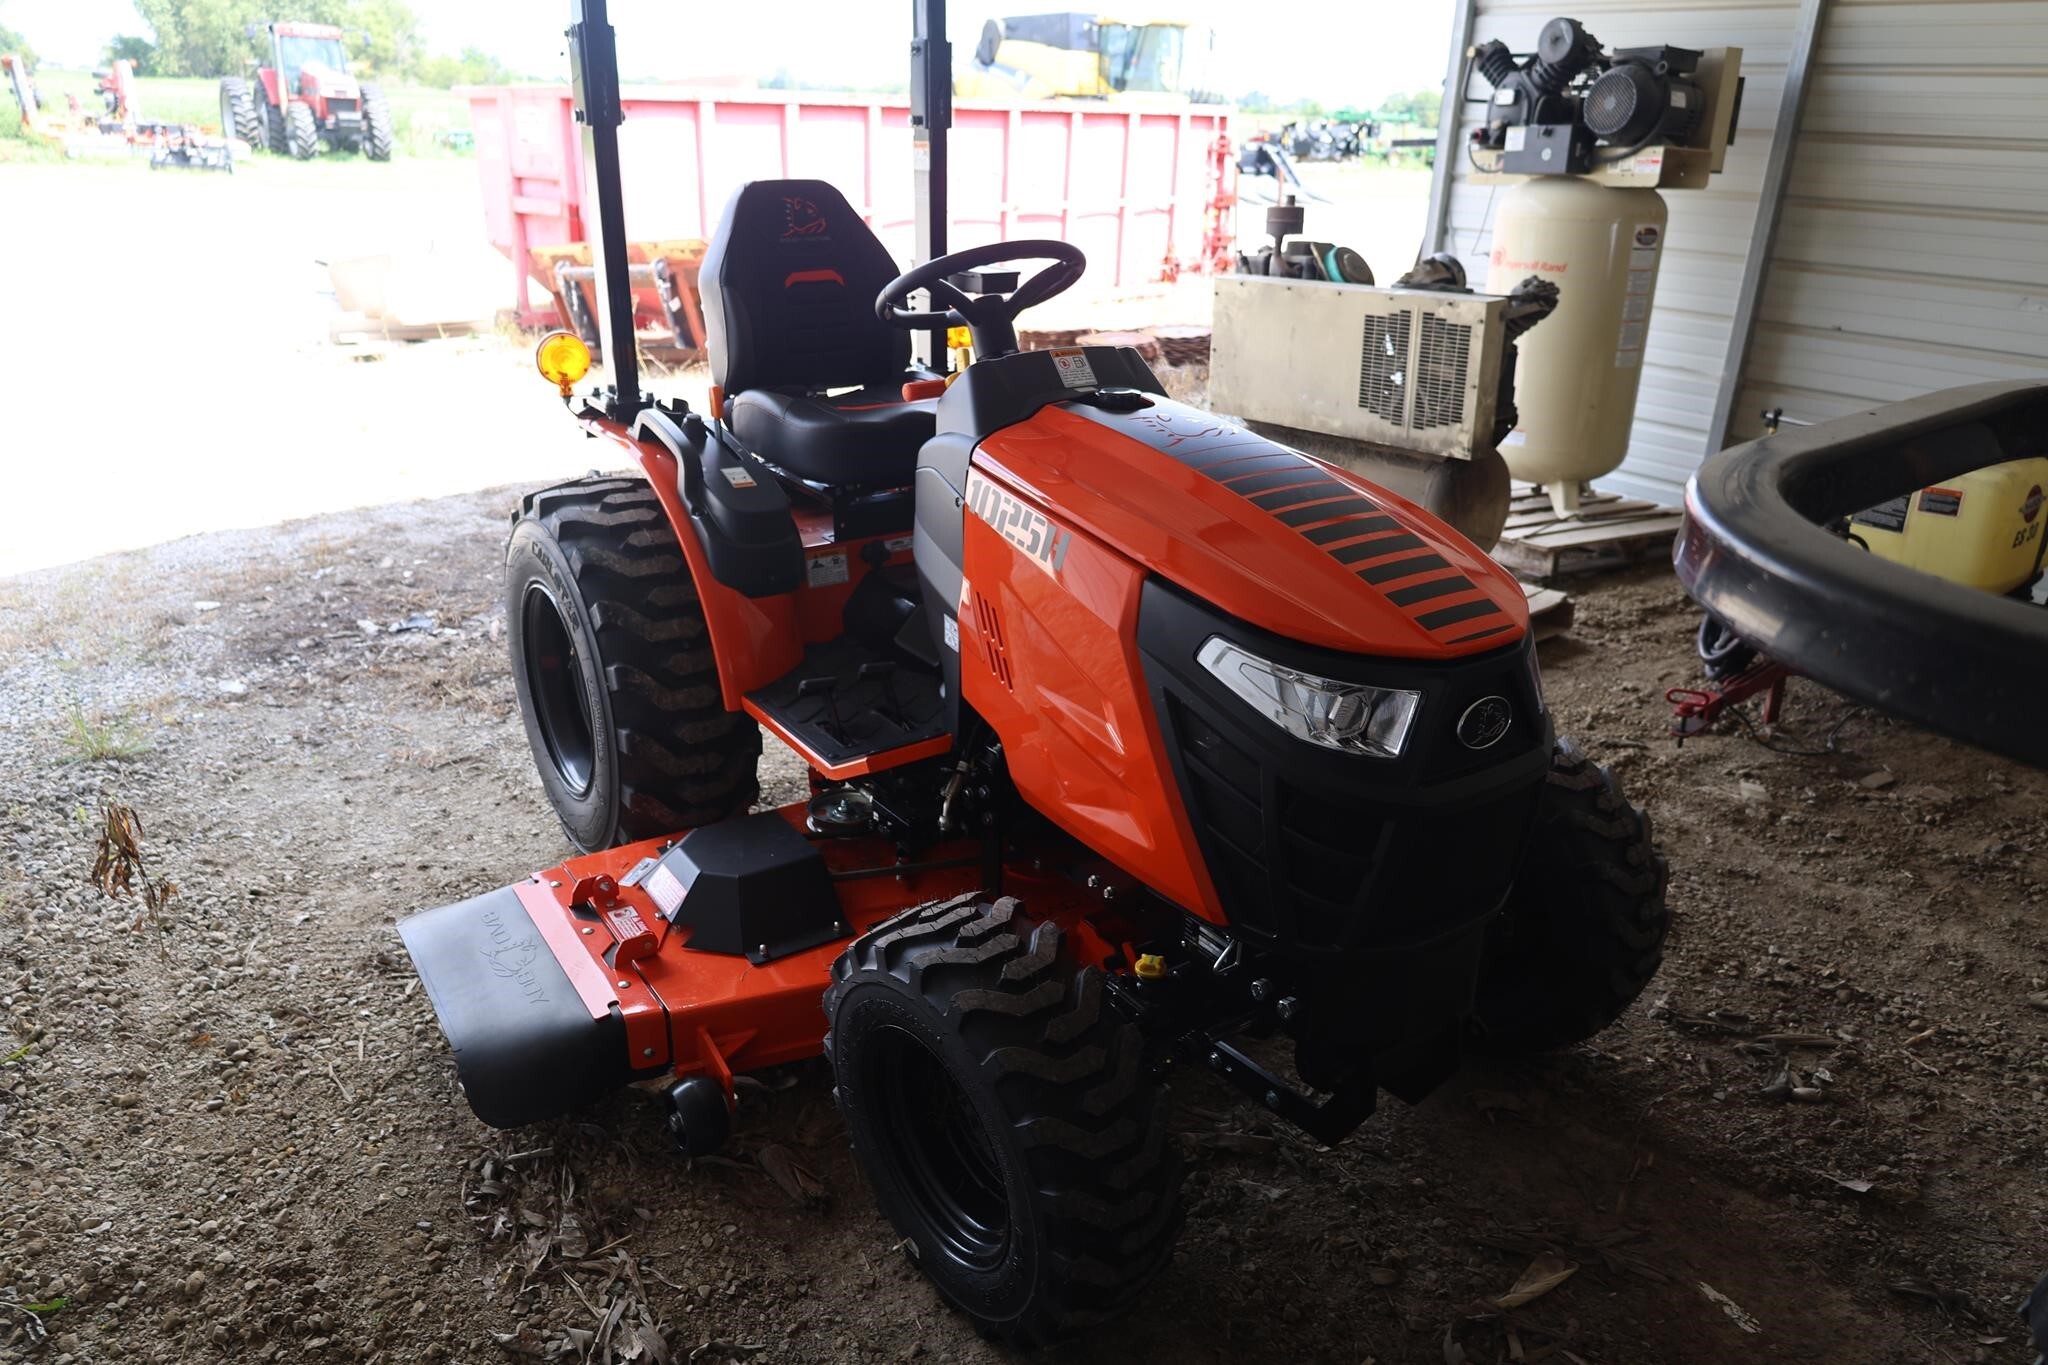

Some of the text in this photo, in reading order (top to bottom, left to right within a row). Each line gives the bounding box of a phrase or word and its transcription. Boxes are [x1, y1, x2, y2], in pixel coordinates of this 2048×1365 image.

[968, 479, 1073, 571] 1025H
[480, 911, 551, 1005] BAD BOY
